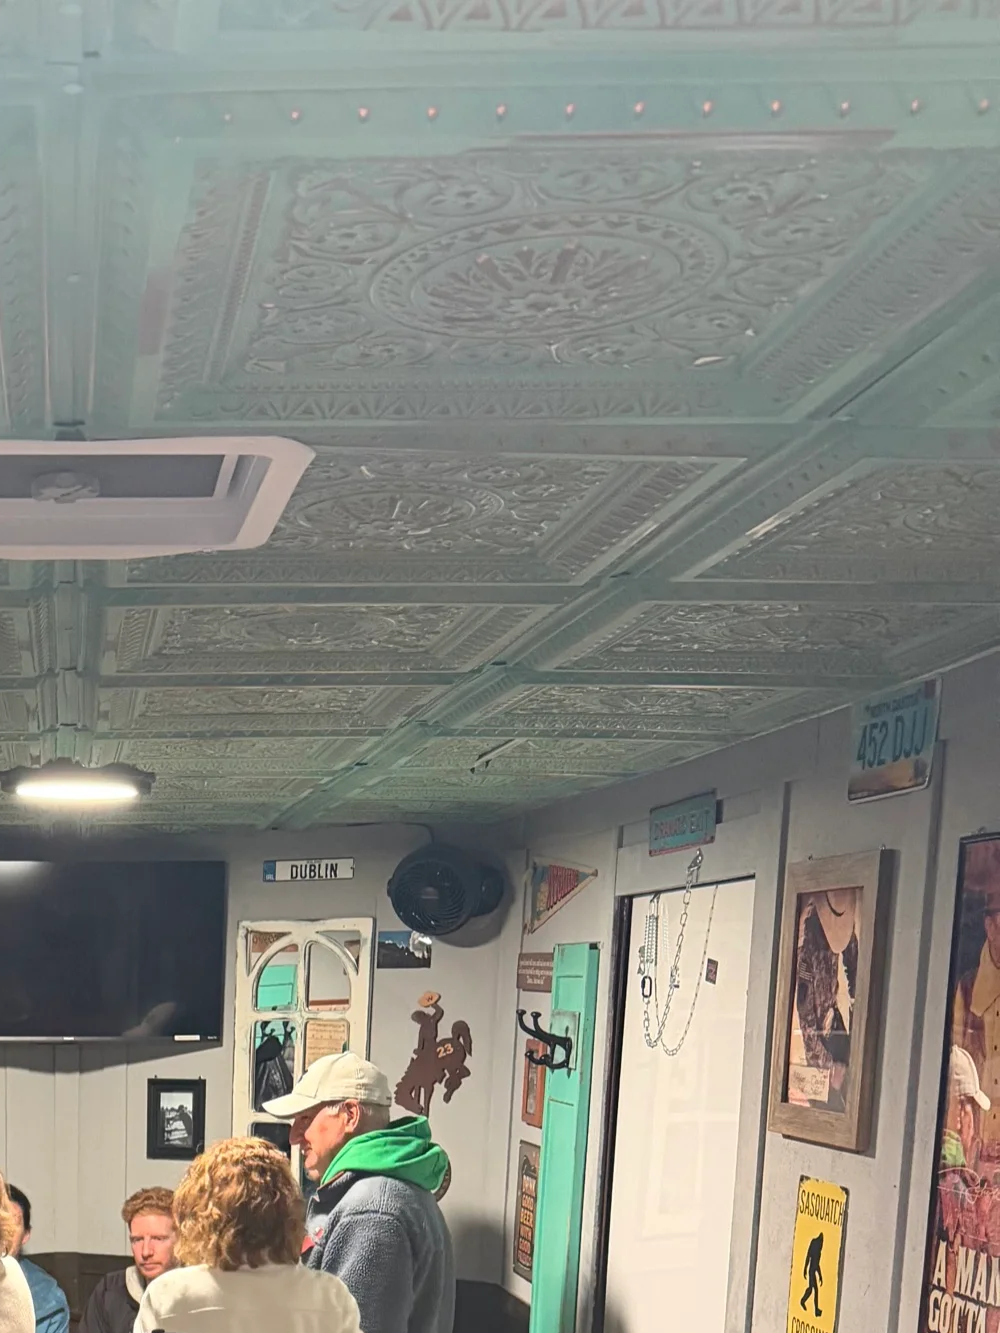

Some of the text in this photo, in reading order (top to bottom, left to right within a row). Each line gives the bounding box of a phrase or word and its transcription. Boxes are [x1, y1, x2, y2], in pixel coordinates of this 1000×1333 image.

[857, 706, 928, 770] 452 DJJ
[290, 863, 338, 879] DUBLIN
[437, 1043, 453, 1058] 23
[520, 1207, 534, 1228] BEER
[799, 1189, 843, 1228] SASQUATCH
[932, 1240, 1000, 1307] A MAN
